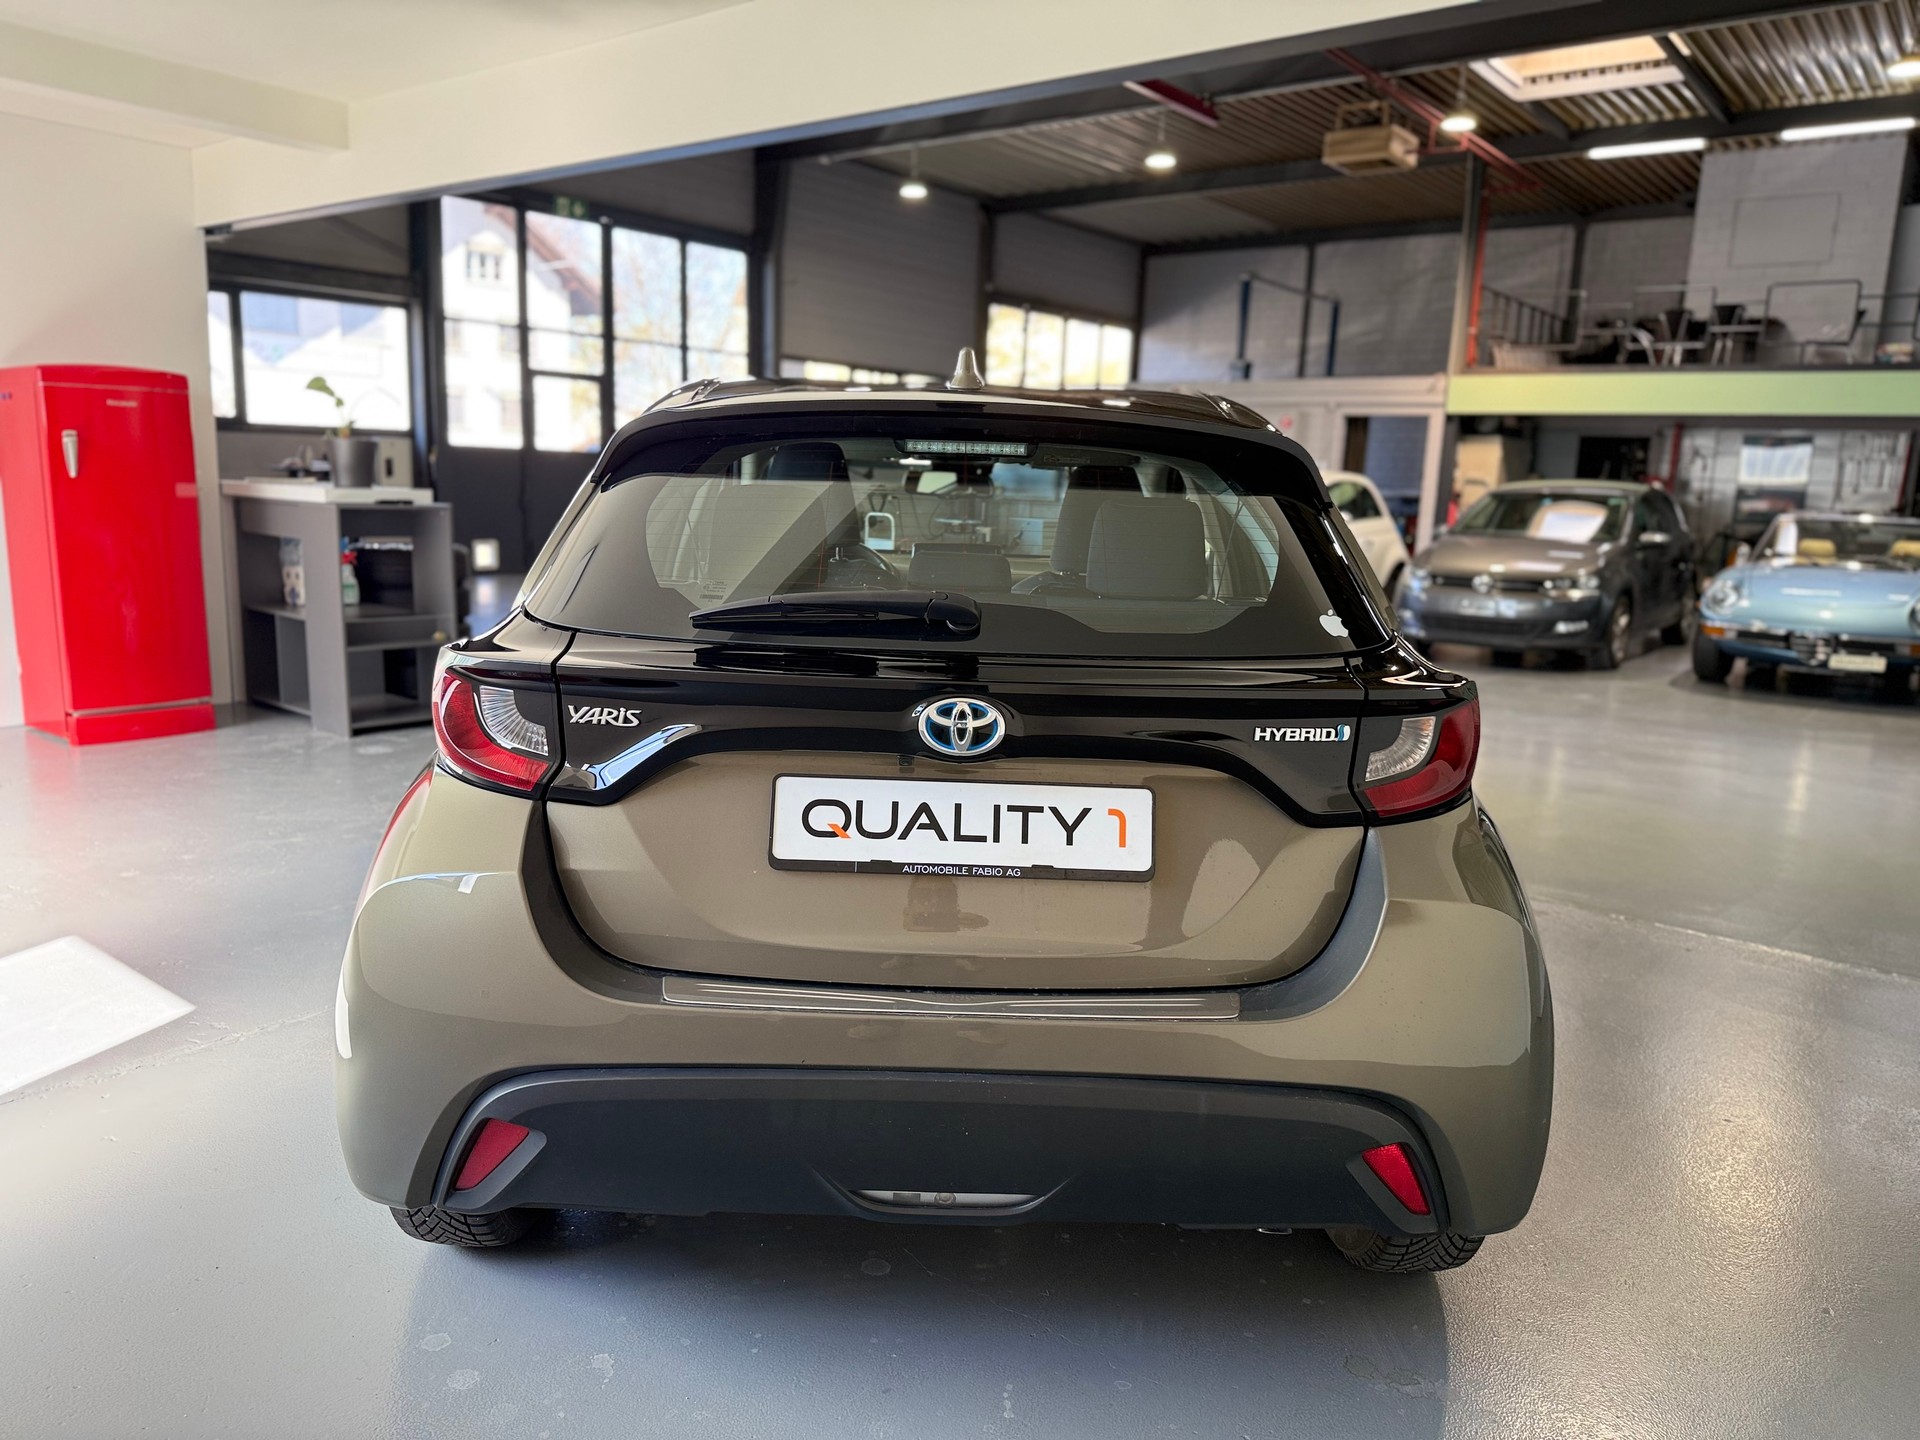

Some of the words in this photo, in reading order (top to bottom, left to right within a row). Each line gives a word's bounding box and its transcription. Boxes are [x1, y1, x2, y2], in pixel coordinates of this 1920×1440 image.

[568, 705, 642, 727] YARIS
[1254, 727, 1338, 742] HYBRID
[802, 798, 1093, 846] QUALITY
[1107, 808, 1127, 848] 1
[902, 864, 969, 875] AUTOMOBILE
[972, 866, 1003, 877] FABIO
[1005, 868, 1021, 877] AG
